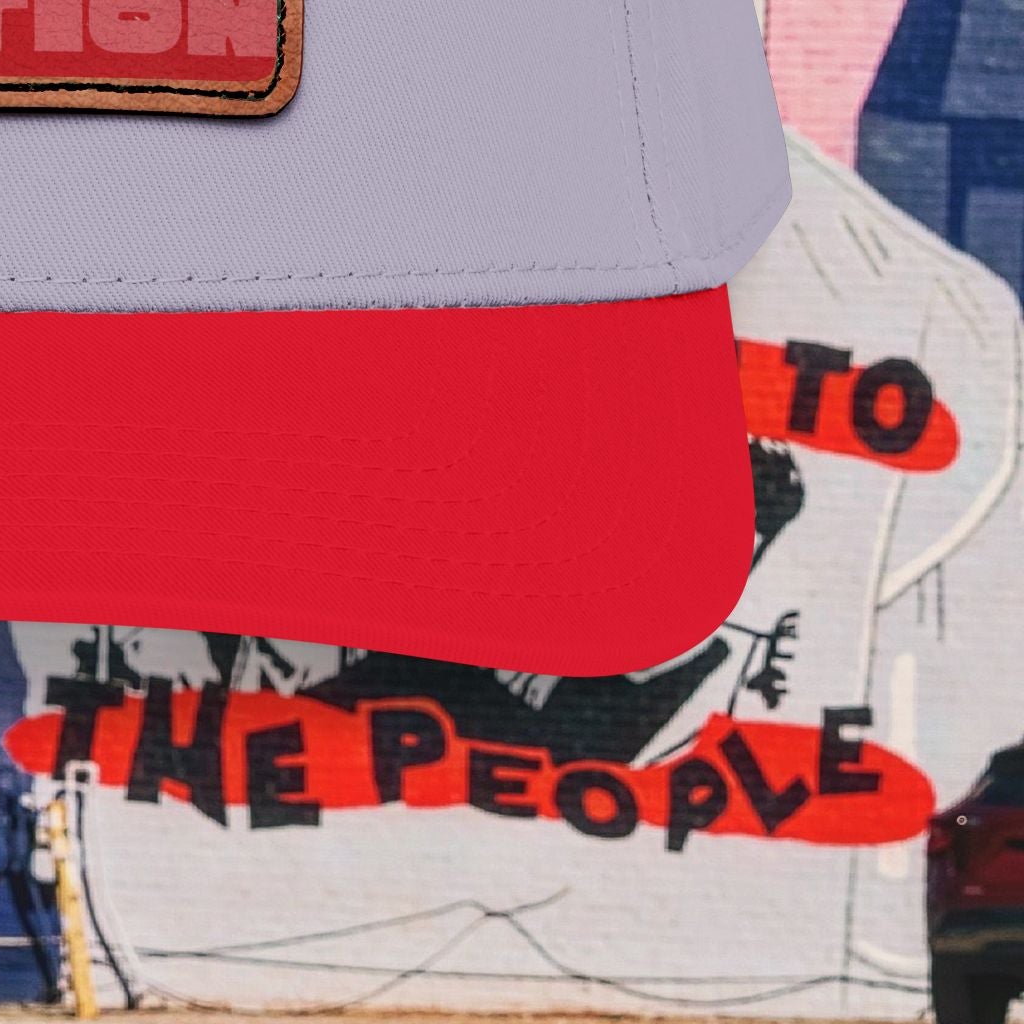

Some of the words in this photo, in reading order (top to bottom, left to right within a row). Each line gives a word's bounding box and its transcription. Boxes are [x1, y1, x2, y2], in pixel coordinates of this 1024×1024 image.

[783, 339, 933, 455] TO
[46, 676, 322, 830] THE
[369, 707, 883, 852] PEOPLE
